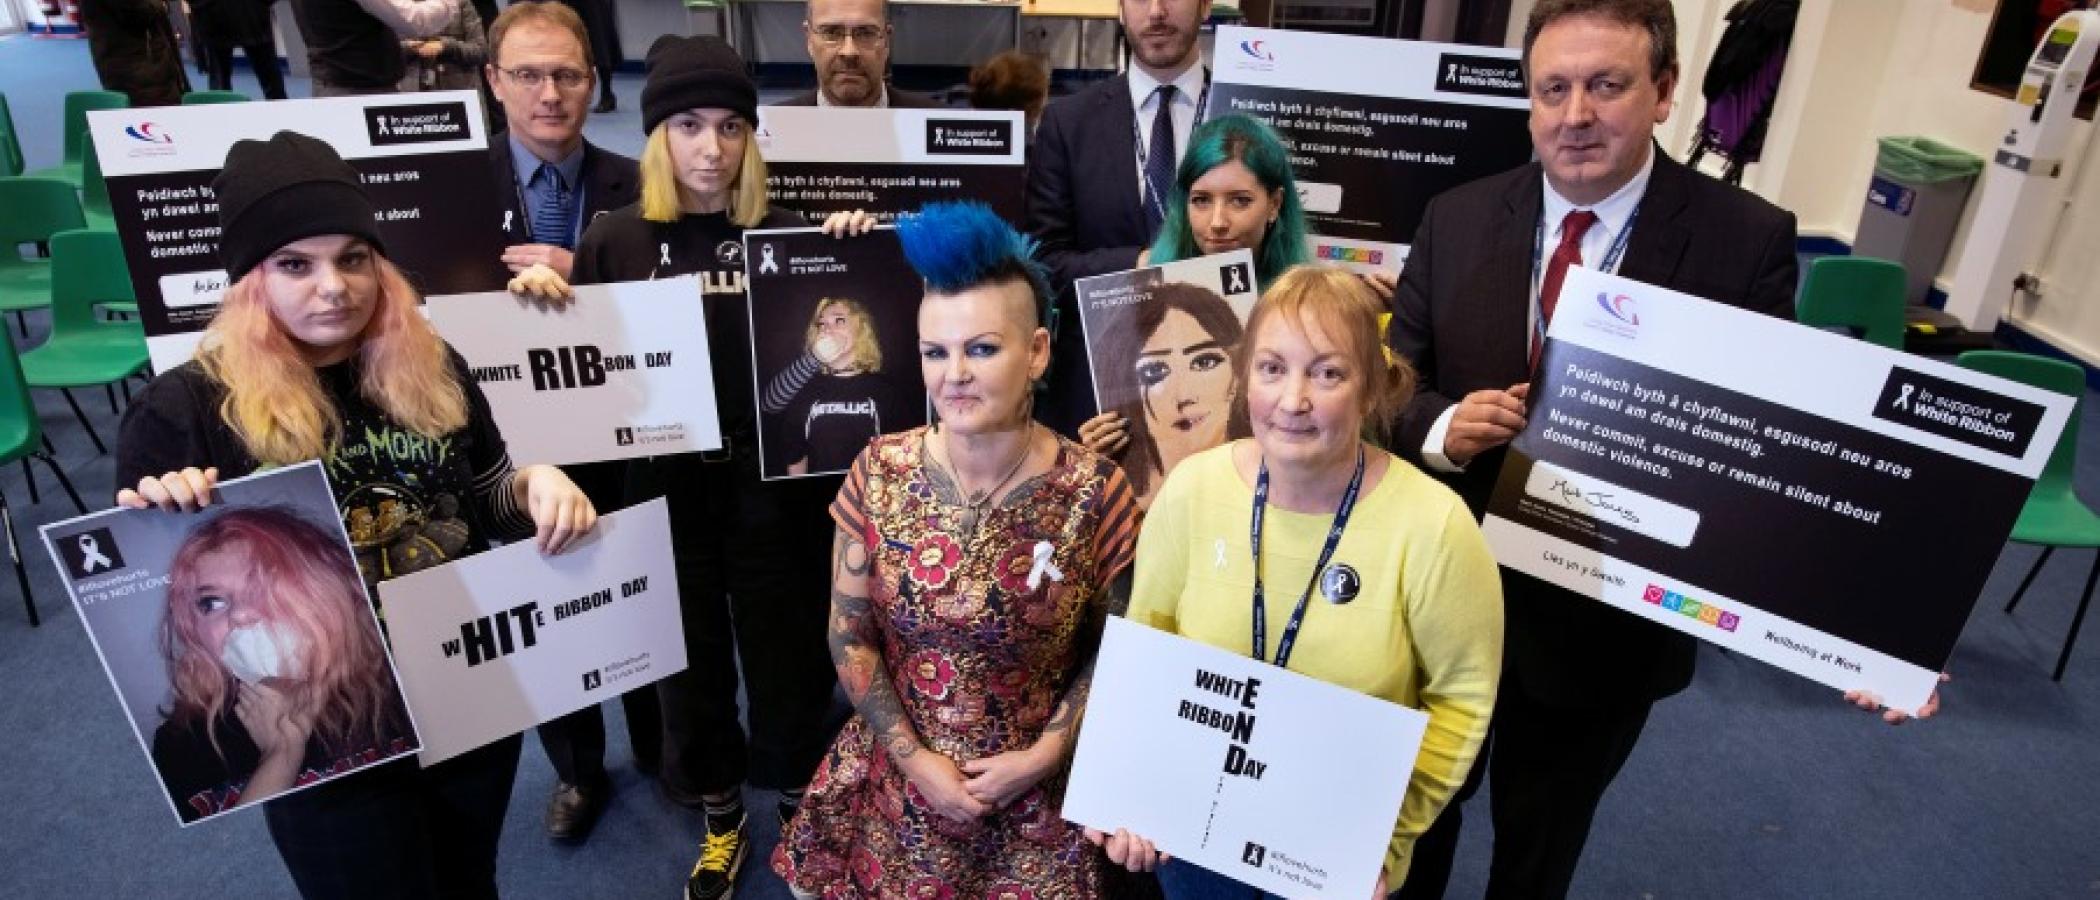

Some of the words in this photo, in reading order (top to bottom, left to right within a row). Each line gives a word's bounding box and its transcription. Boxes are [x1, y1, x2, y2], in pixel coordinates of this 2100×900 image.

[469, 362, 523, 382] WHITE
[644, 351, 673, 369] DAY
[1559, 383, 1578, 399] yn
[1580, 388, 1624, 412] dawel
[1624, 403, 1648, 420] am
[1650, 410, 1689, 434] drais
[1691, 423, 1766, 460] domestig.
[1566, 363, 1631, 394] Peidiwch
[1632, 382, 1667, 404] byth
[1682, 400, 1759, 436] chyflawni,
[1763, 425, 1838, 457] esgusodi
[1838, 446, 1871, 468] neu
[1873, 457, 1913, 481] aros
[1914, 401, 1959, 427] White
[1958, 415, 2015, 443] Ribbon
[1917, 386, 1934, 402] In
[1934, 395, 1992, 420] support
[1994, 410, 2013, 425] of
[1542, 426, 1607, 457] domestic
[1610, 449, 1673, 480] violence.
[1549, 407, 1590, 432] Never
[1591, 423, 1648, 453] commit,
[1652, 442, 1705, 469] excuse
[1708, 460, 1726, 475] or
[1727, 465, 1782, 494] remain
[1784, 484, 1832, 510] silent
[1832, 500, 1882, 526] about
[553, 587, 614, 622] RIBBON
[620, 575, 649, 598] DAY
[1194, 668, 1263, 710] WHITE
[1177, 699, 1256, 745] RIBBON
[1222, 743, 1268, 781] DAY
